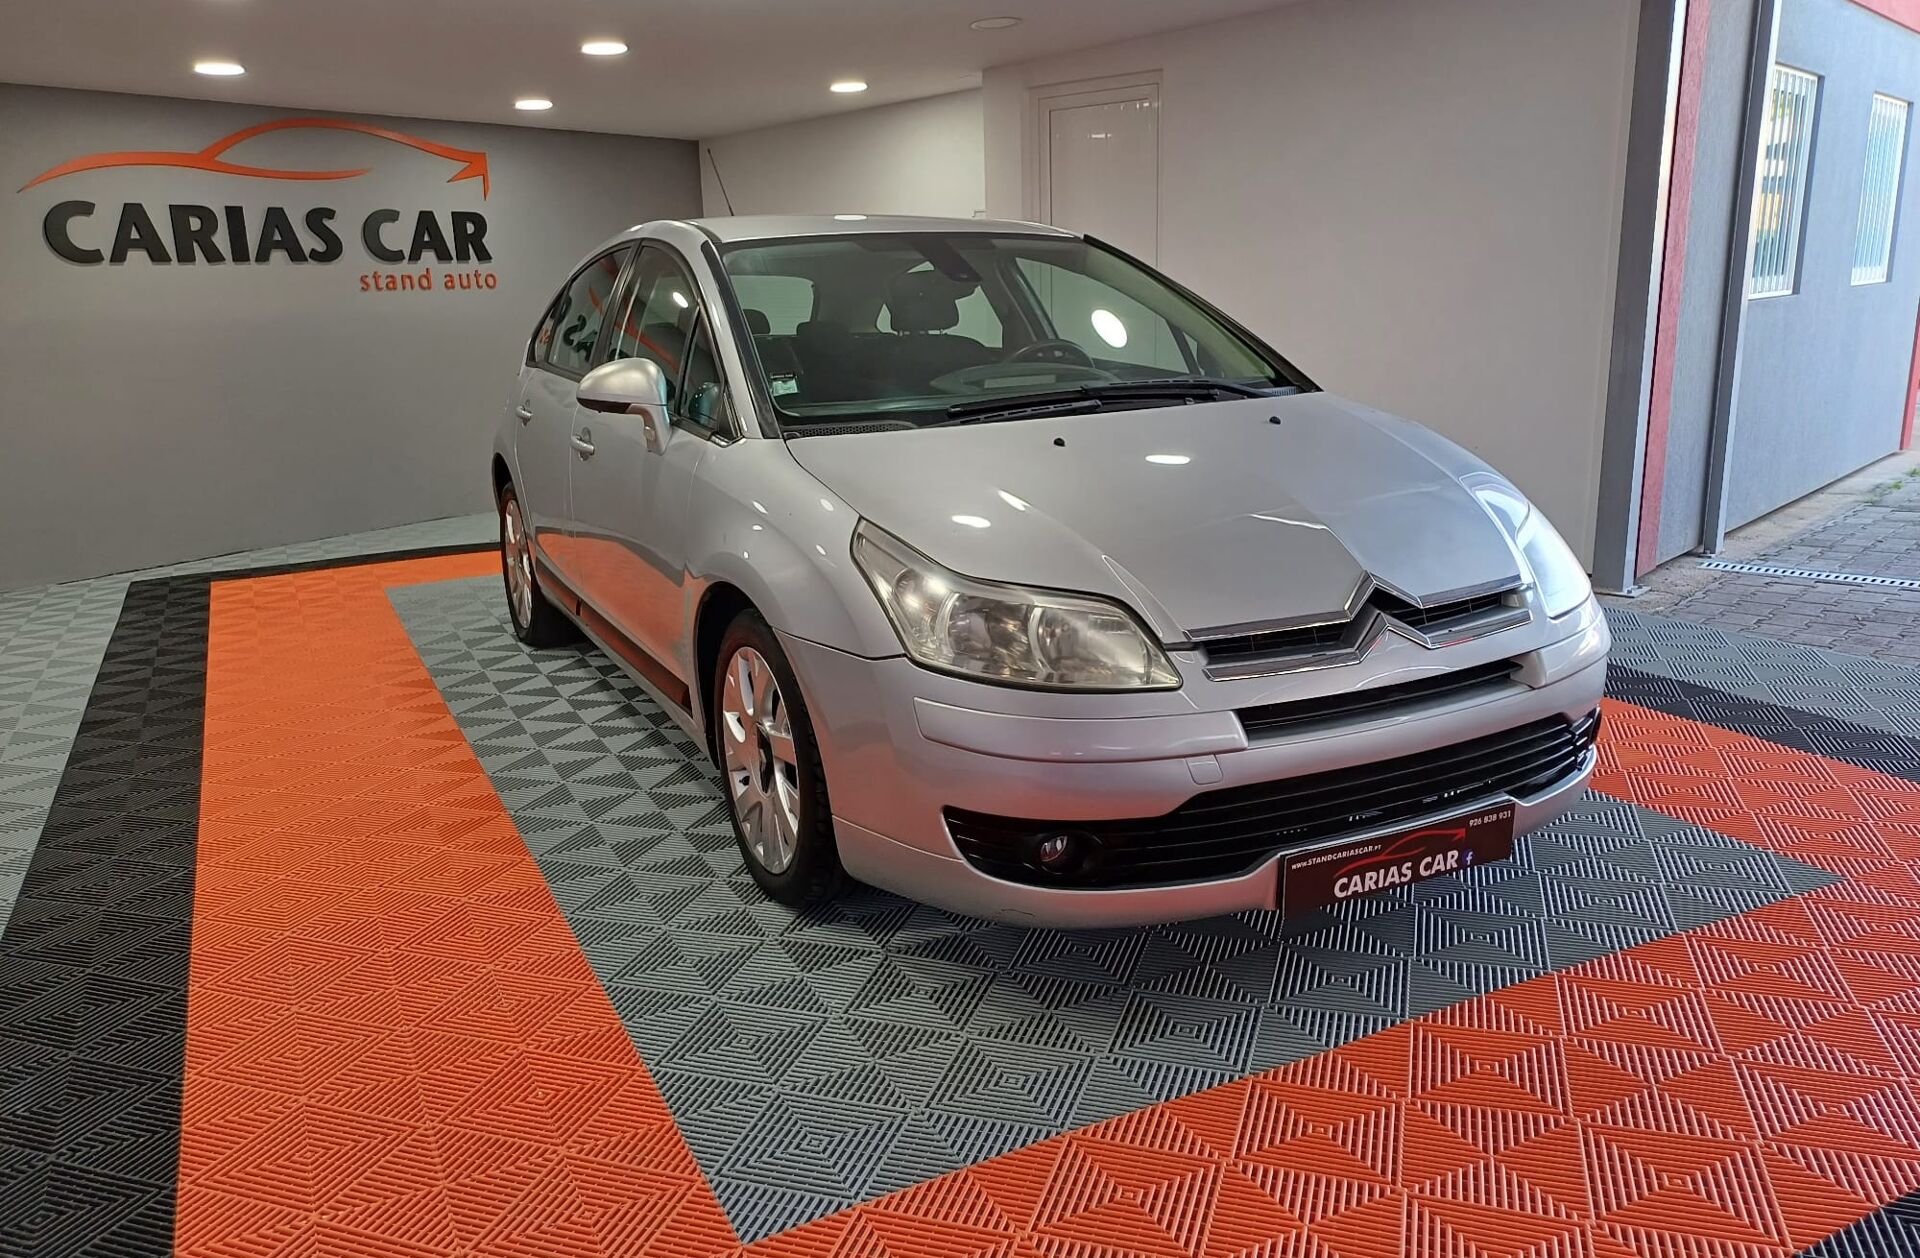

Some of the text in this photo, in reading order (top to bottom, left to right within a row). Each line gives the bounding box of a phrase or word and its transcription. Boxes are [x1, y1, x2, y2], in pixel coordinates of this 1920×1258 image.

[43, 200, 493, 264] CARIAS CAR
[360, 268, 498, 291] stand auto
[1499, 810, 1511, 819] 931
[1333, 850, 1459, 898] CARIAS CAR
